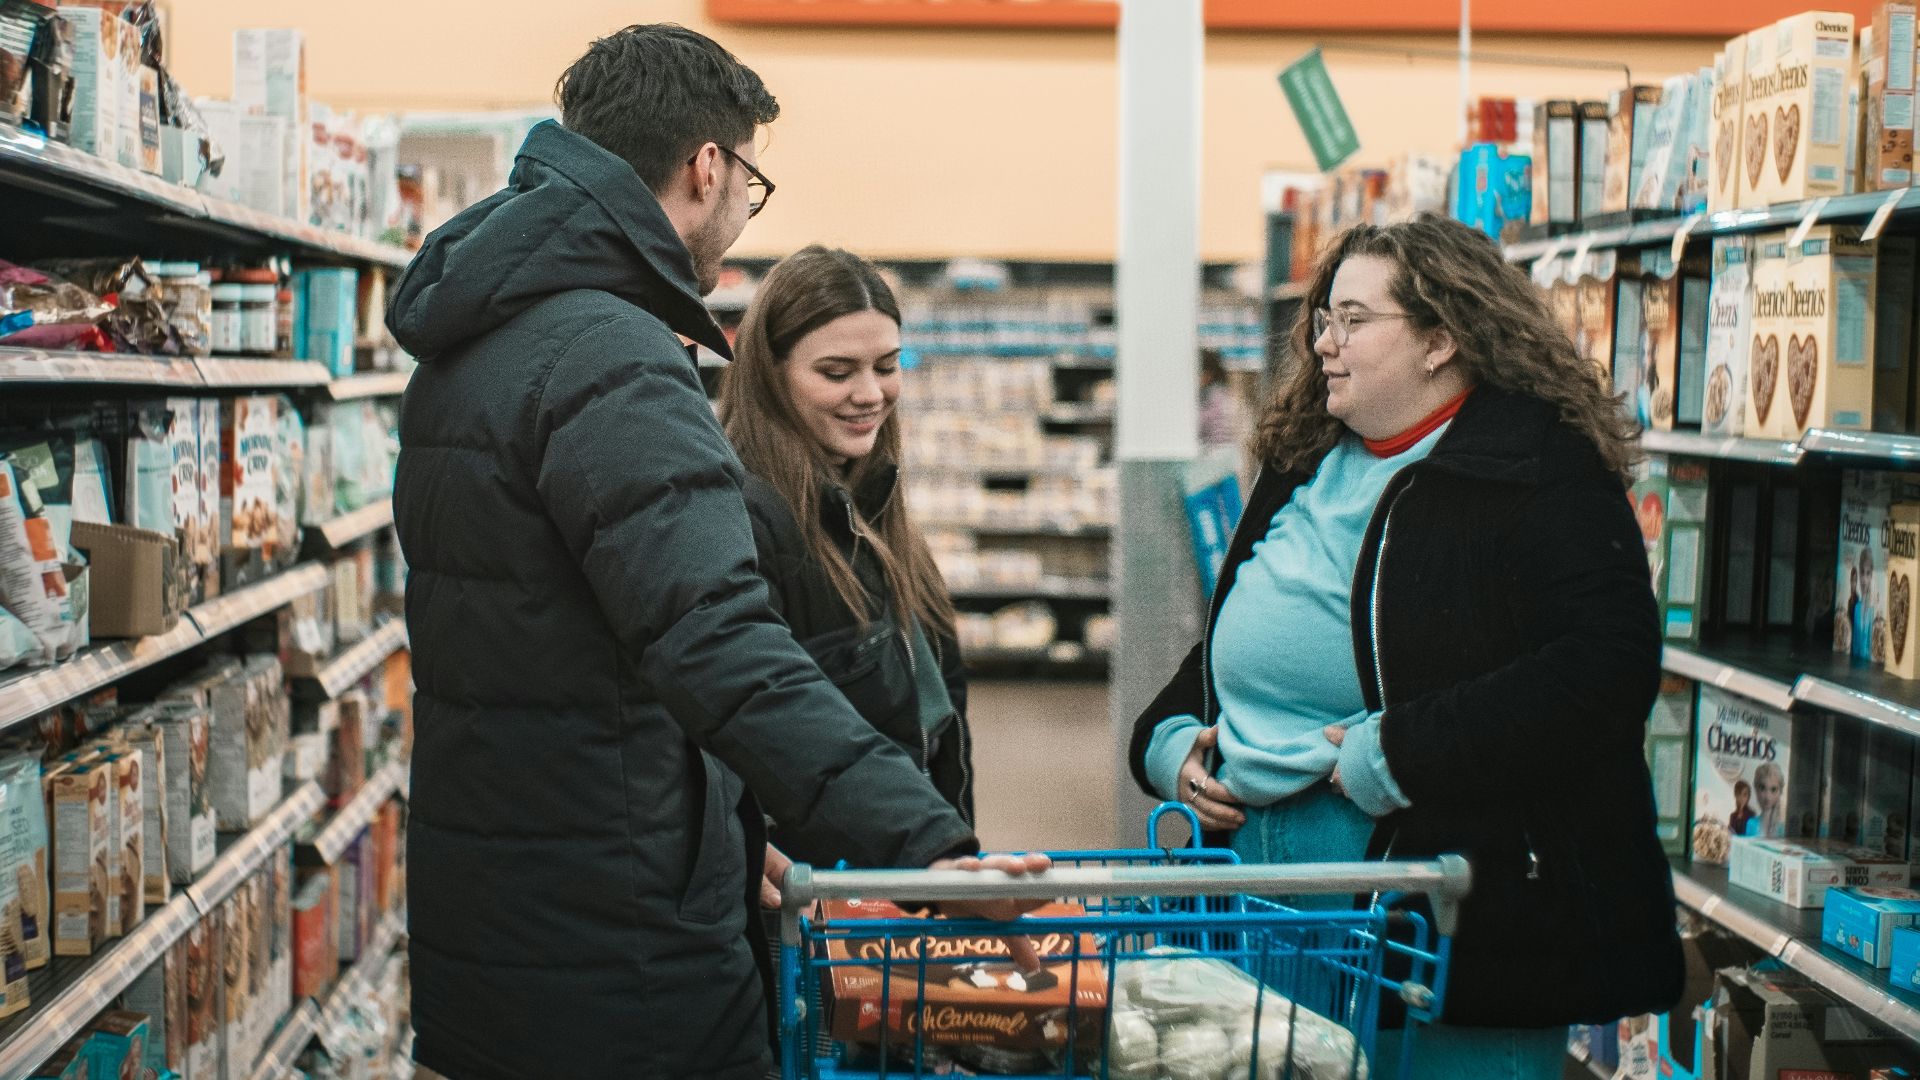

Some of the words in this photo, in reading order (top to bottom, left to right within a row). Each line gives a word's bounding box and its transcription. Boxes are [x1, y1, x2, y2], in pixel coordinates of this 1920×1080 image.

[1815, 21, 1848, 33] Cheerios
[1774, 62, 1808, 93] Cheerios
[1784, 281, 1825, 318] Cheerios
[1842, 512, 1870, 545] Cheerios
[1708, 722, 1776, 761] Cheerios
[1845, 876, 1869, 887] CORN
